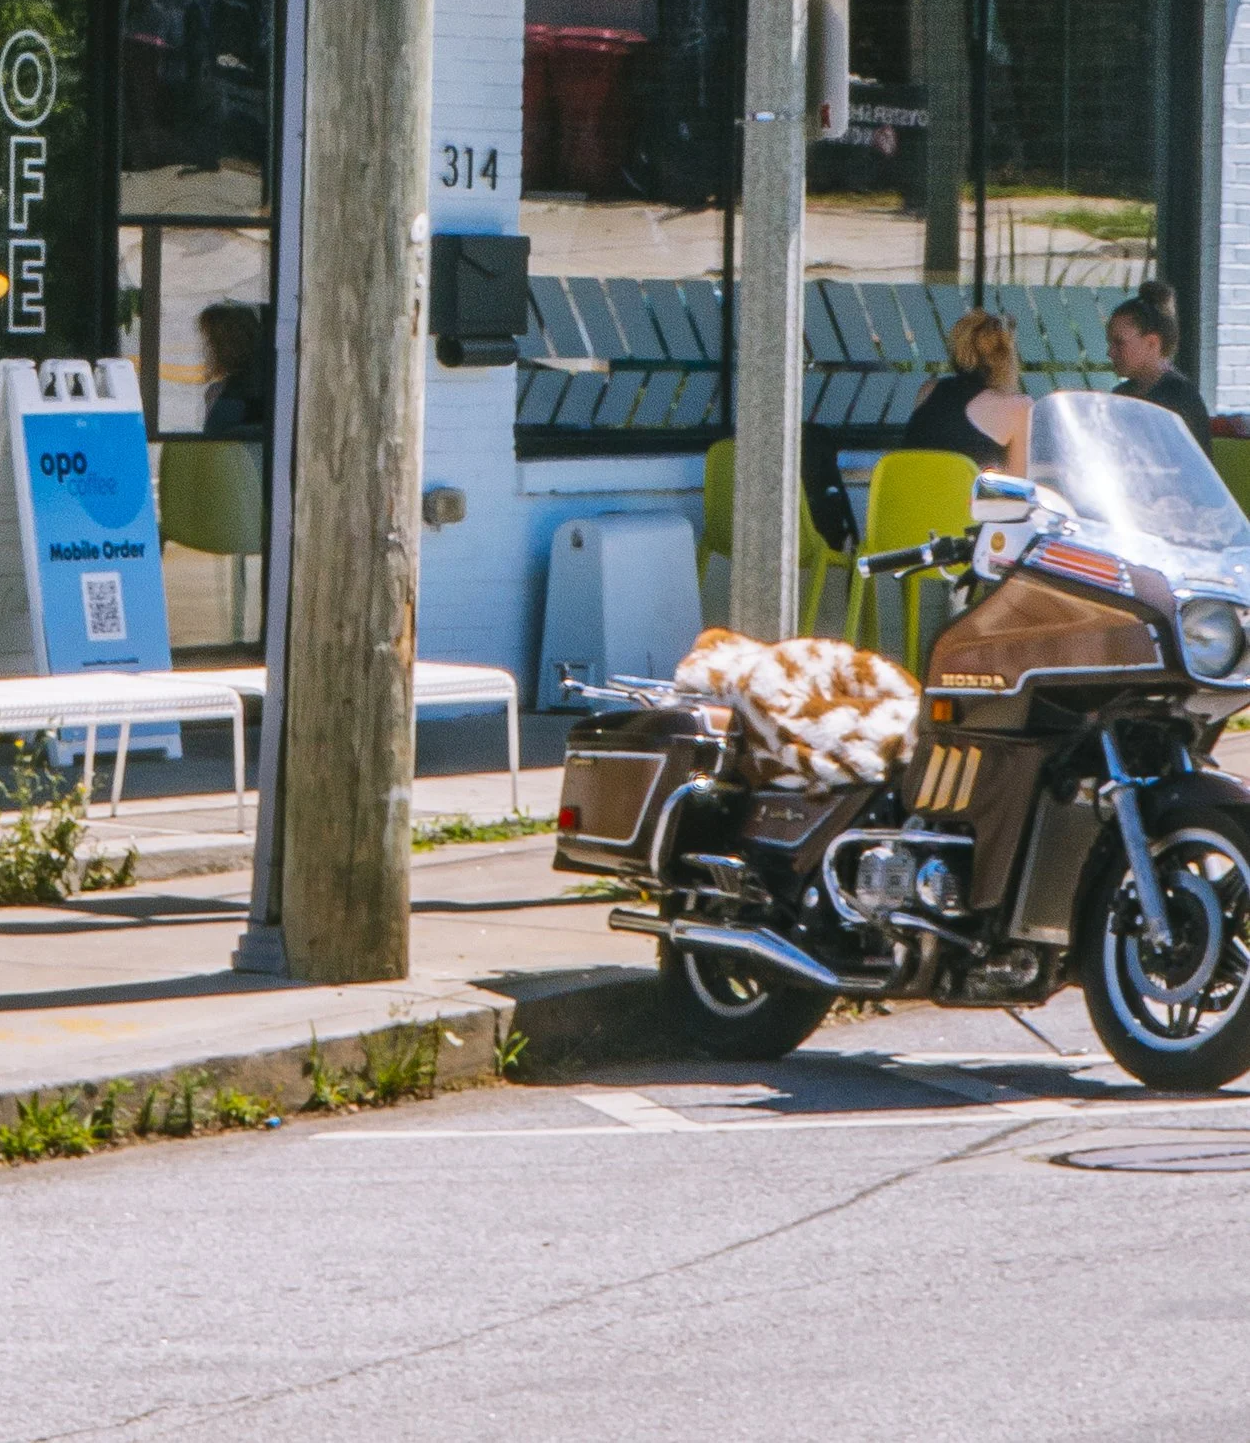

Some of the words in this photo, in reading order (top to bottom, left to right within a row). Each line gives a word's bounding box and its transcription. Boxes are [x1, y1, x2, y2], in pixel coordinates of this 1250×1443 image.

[440, 144, 499, 191] 314
[40, 452, 88, 483] opo
[67, 473, 118, 497] coffee
[49, 543, 100, 562] Mobile
[103, 540, 146, 559] Order
[941, 672, 1007, 688] HONDA
